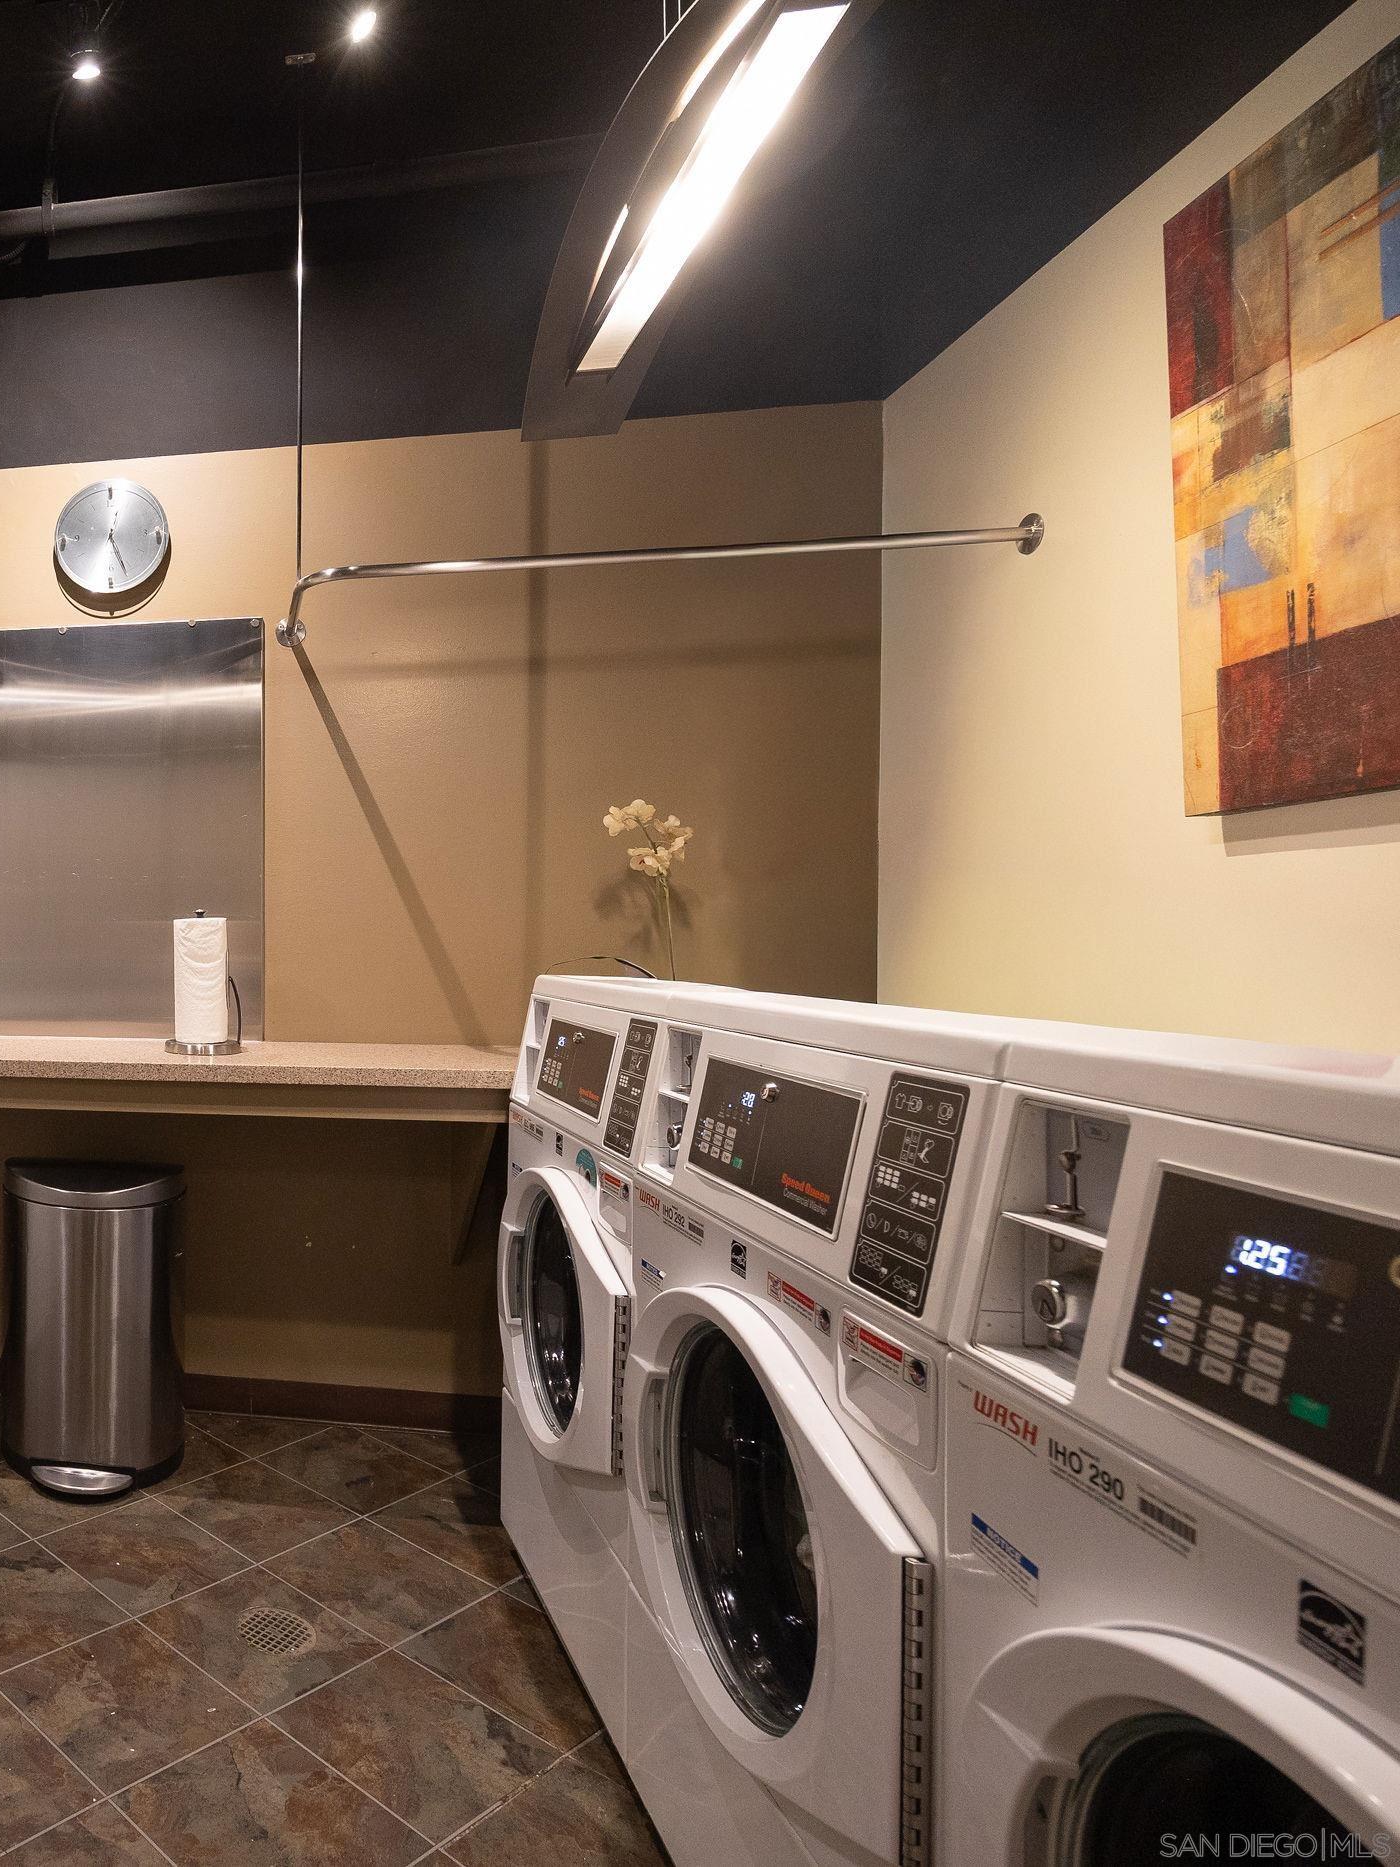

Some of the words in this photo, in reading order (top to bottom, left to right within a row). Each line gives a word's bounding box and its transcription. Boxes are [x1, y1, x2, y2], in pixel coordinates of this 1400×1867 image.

[640, 1187, 660, 1212] WASH
[973, 1390, 1039, 1447] WASH
[1089, 1463, 1125, 1501] 290
